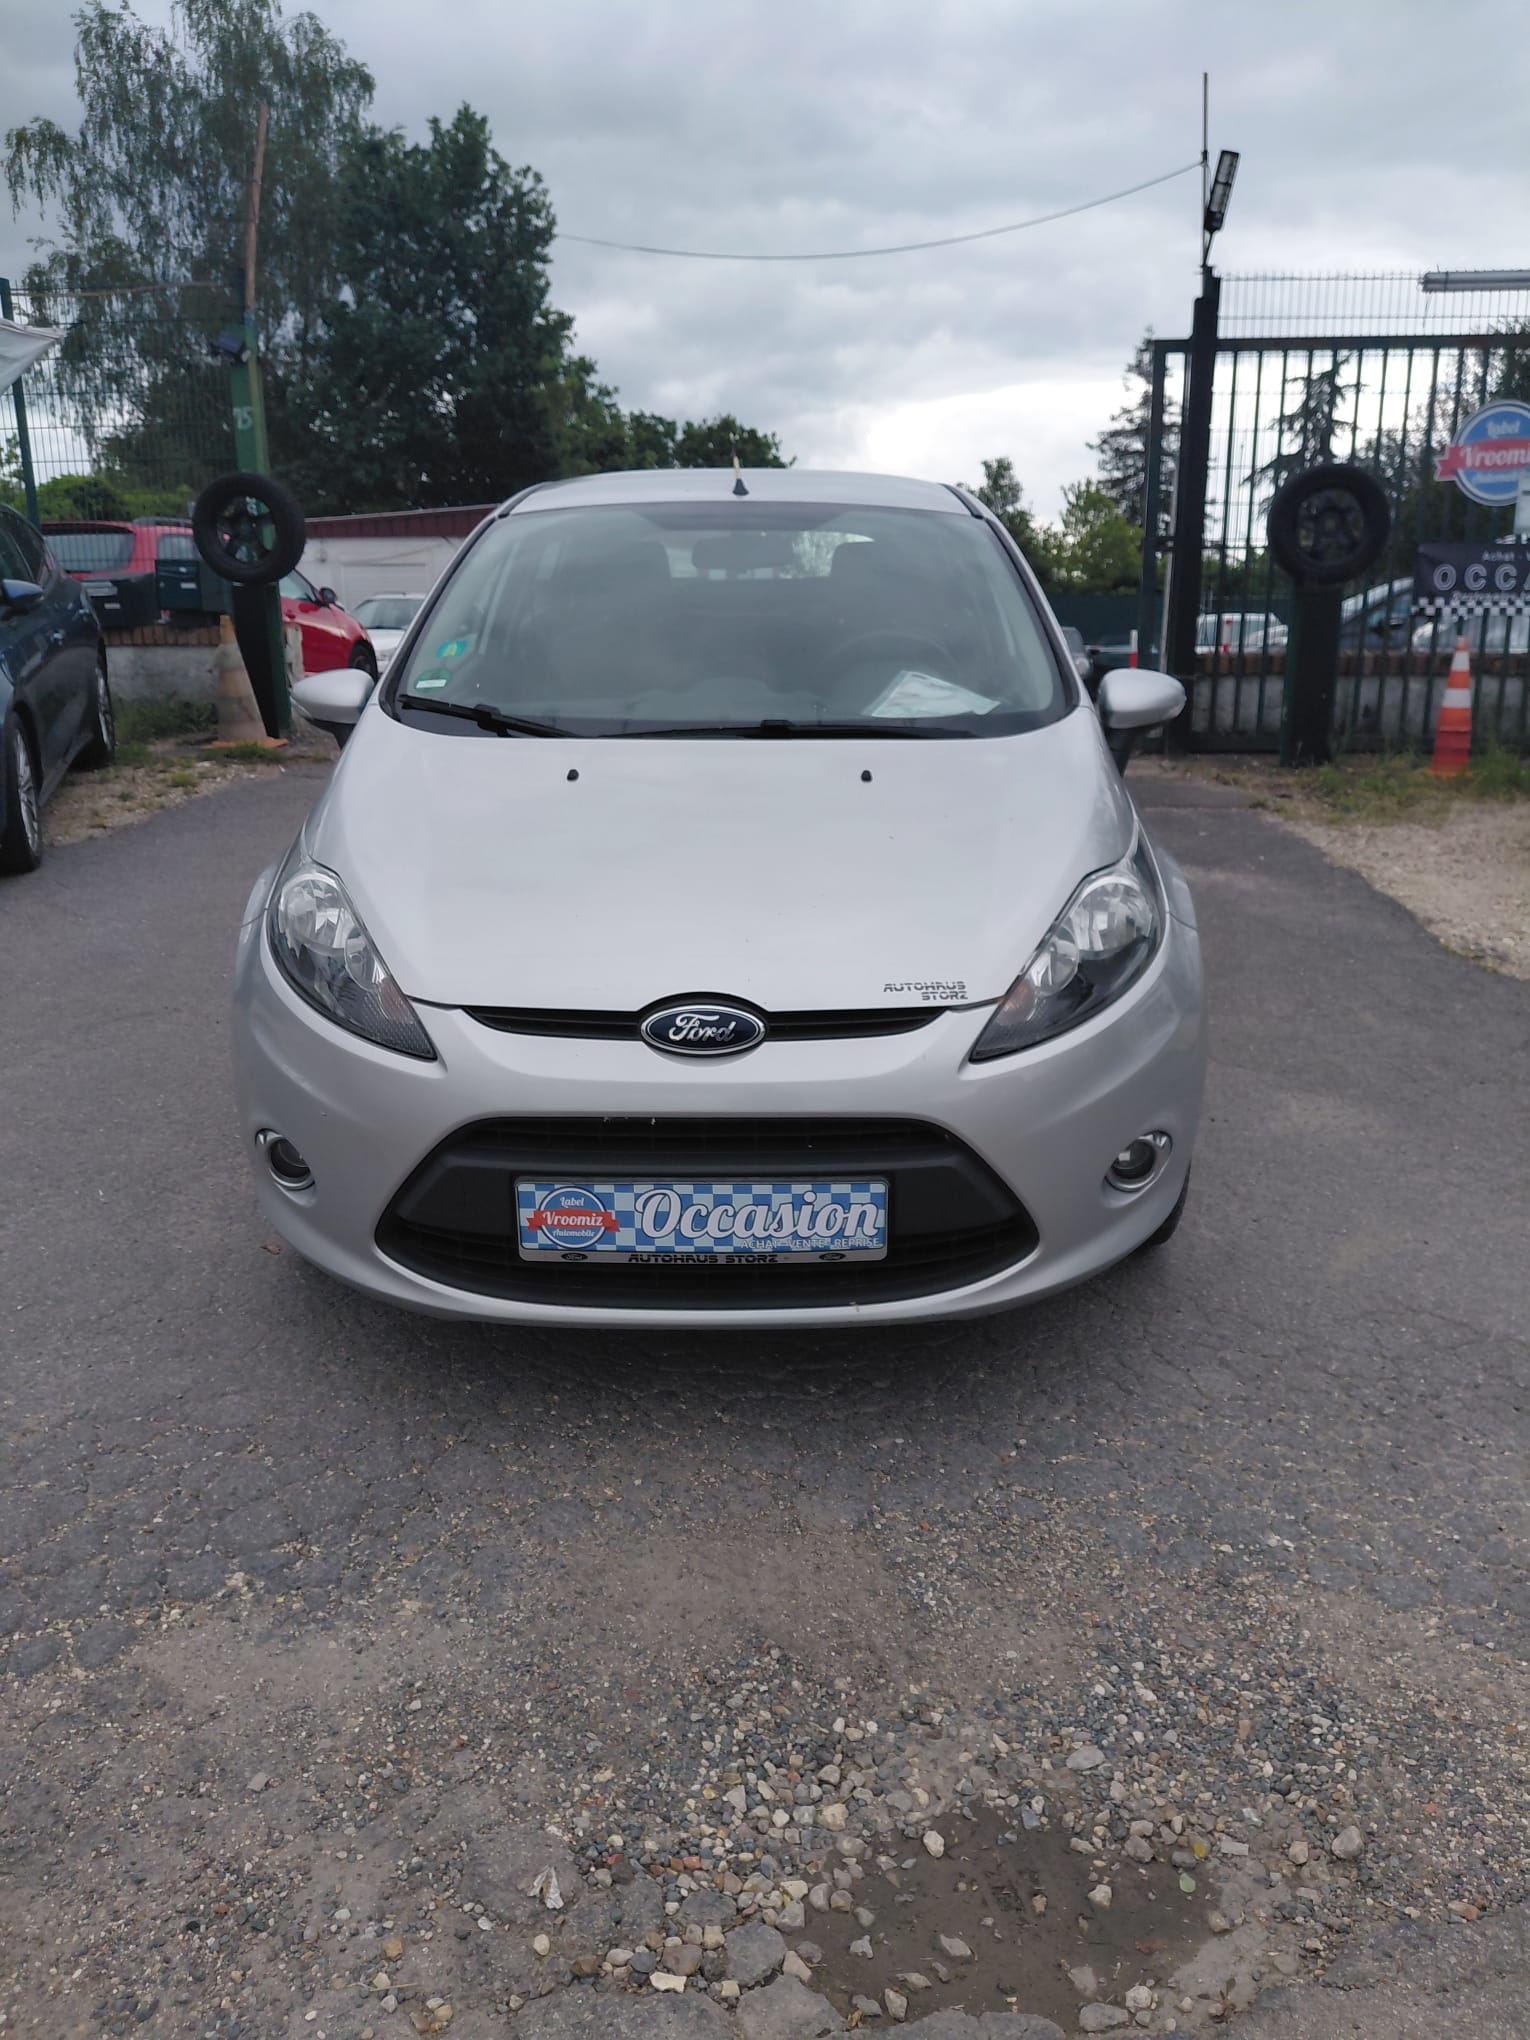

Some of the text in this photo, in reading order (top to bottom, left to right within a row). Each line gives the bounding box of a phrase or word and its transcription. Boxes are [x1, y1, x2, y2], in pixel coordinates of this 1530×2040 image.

[1433, 563, 1530, 591] OCC
[883, 981, 966, 992] AUTOHAUS
[920, 991, 969, 1001] STORZ
[668, 1013, 736, 1042] Ford
[560, 1197, 585, 1208] Label
[542, 1211, 604, 1226] Vroomiz
[634, 1188, 878, 1239] Occasion
[741, 1237, 880, 1249] ACHAT VENTE REPRISE
[628, 1253, 778, 1264] AUTOHAUS STORZ
